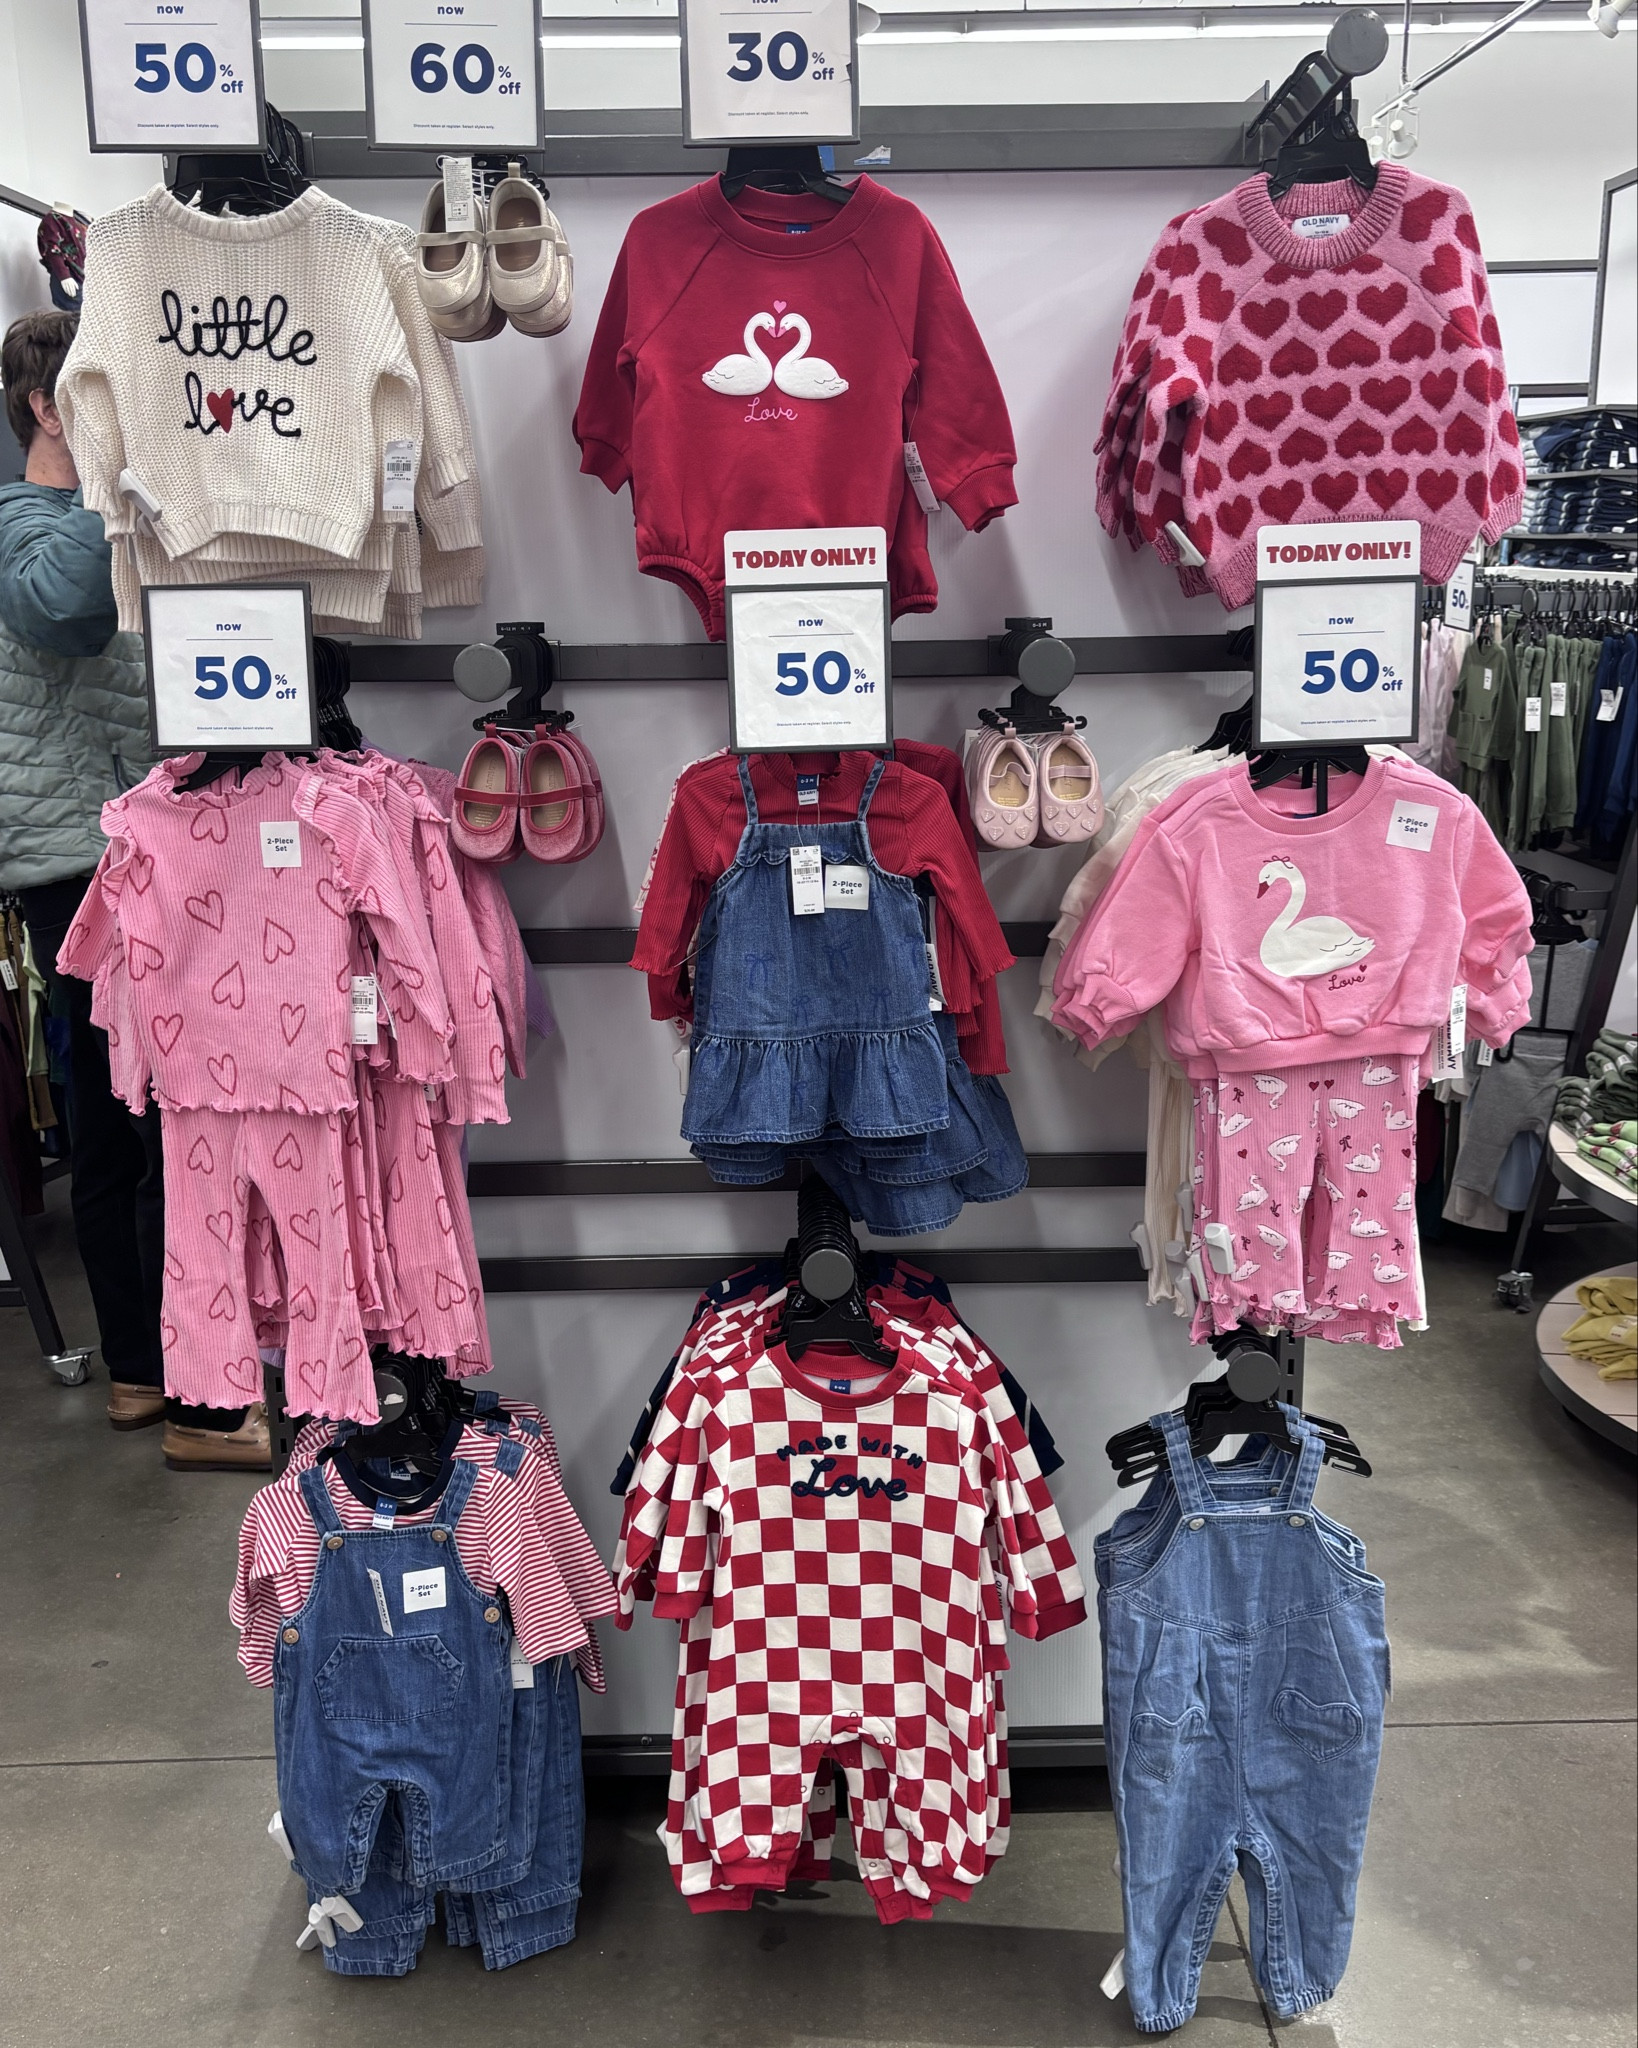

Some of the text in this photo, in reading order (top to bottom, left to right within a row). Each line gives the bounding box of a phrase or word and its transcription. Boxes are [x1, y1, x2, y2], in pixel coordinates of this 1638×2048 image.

[157, 5, 184, 14] now
[438, 6, 464, 15] now
[727, 31, 825, 81] 30 %
[134, 42, 233, 93] 50 %
[411, 42, 511, 94] 60 %
[812, 68, 834, 80] off
[221, 80, 243, 93] off
[498, 82, 521, 94] off
[159, 290, 317, 365] little
[745, 397, 798, 422] Love
[732, 547, 876, 569] TODAY ONLY!
[1266, 542, 1411, 563] TODAY ONLY!
[1452, 589, 1465, 608] 50
[798, 618, 824, 627] now
[1329, 616, 1354, 625] now
[194, 656, 287, 700] 50 %
[775, 651, 866, 696] 50 %
[1301, 648, 1395, 694] 50 %
[276, 688, 297, 699] off
[854, 682, 875, 694] off
[1382, 680, 1403, 691] off
[1397, 816, 1428, 827] 2-Piece
[1328, 974, 1365, 991] Love
[777, 1435, 923, 1469] MADE WITH
[791, 1458, 908, 1502] Love
[410, 1584, 438, 1592] 2-Piece
